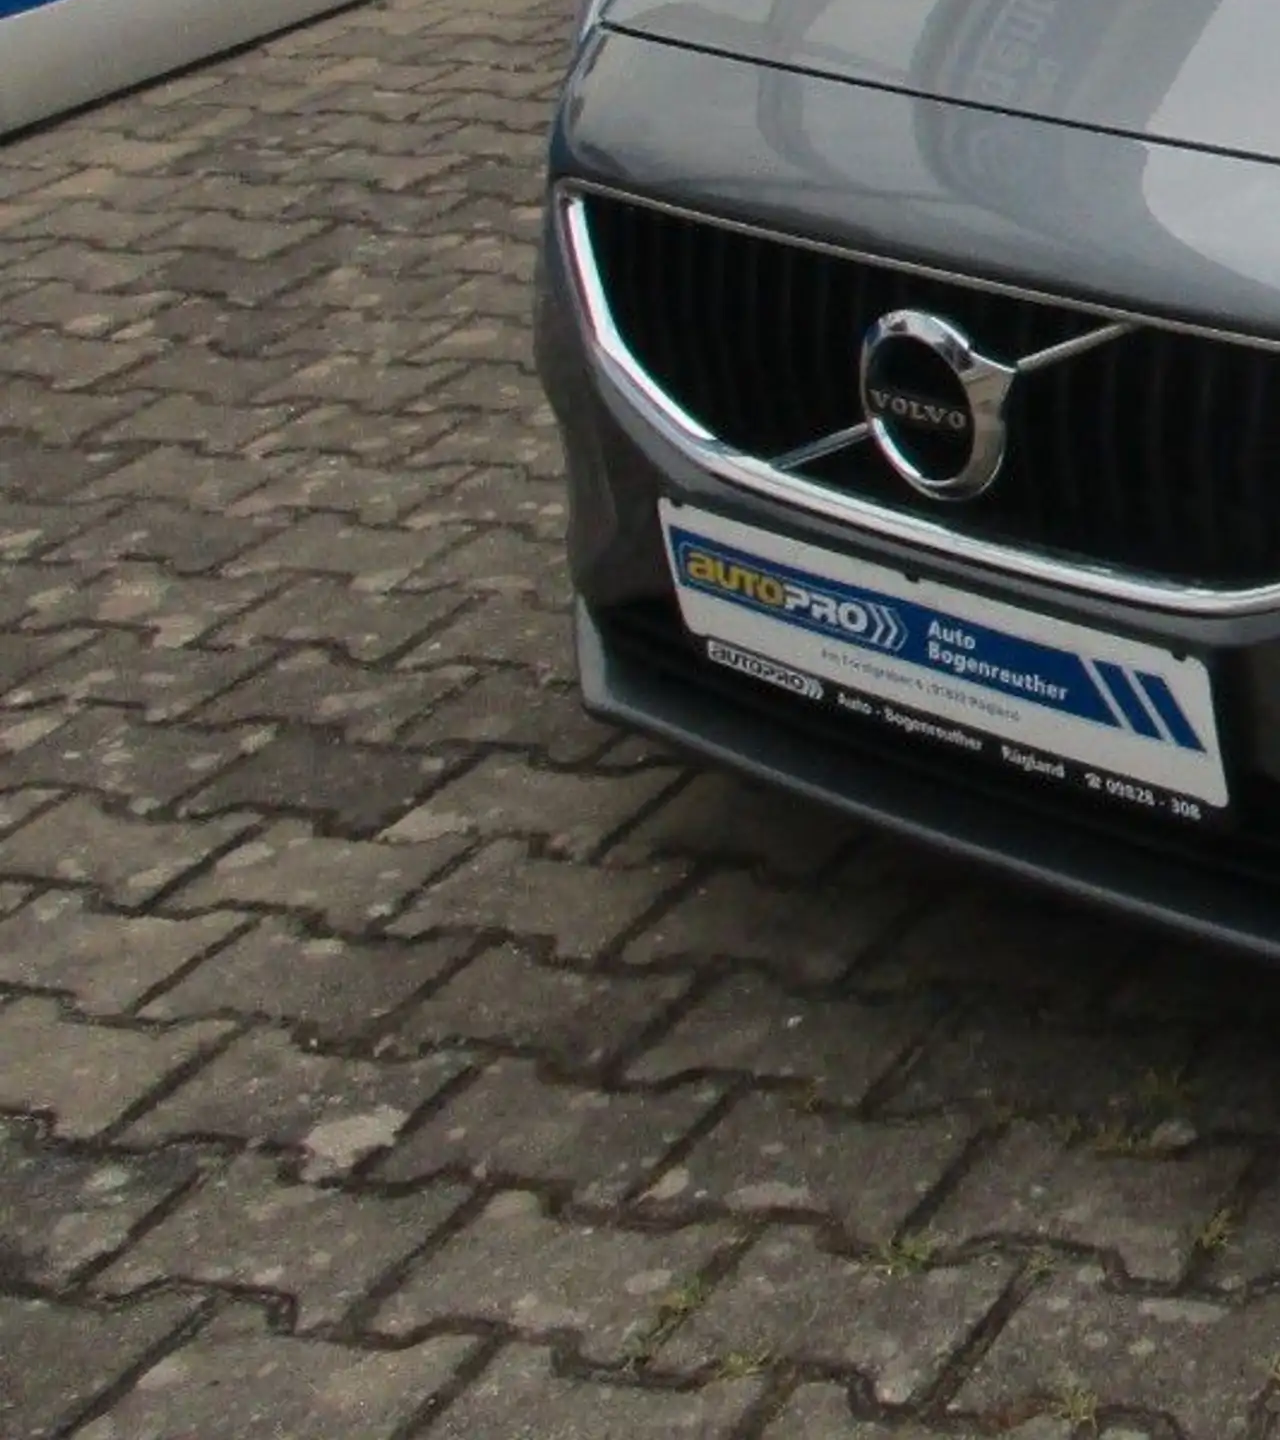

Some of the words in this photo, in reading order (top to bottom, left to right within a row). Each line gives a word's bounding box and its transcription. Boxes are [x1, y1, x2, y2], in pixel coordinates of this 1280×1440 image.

[869, 389, 966, 429] VOLVO
[927, 620, 976, 650] Auto
[927, 642, 1069, 701] Bogenreuther
[837, 691, 872, 714] Auto
[884, 708, 984, 751] Bogenreuther
[1171, 798, 1202, 820] 308
